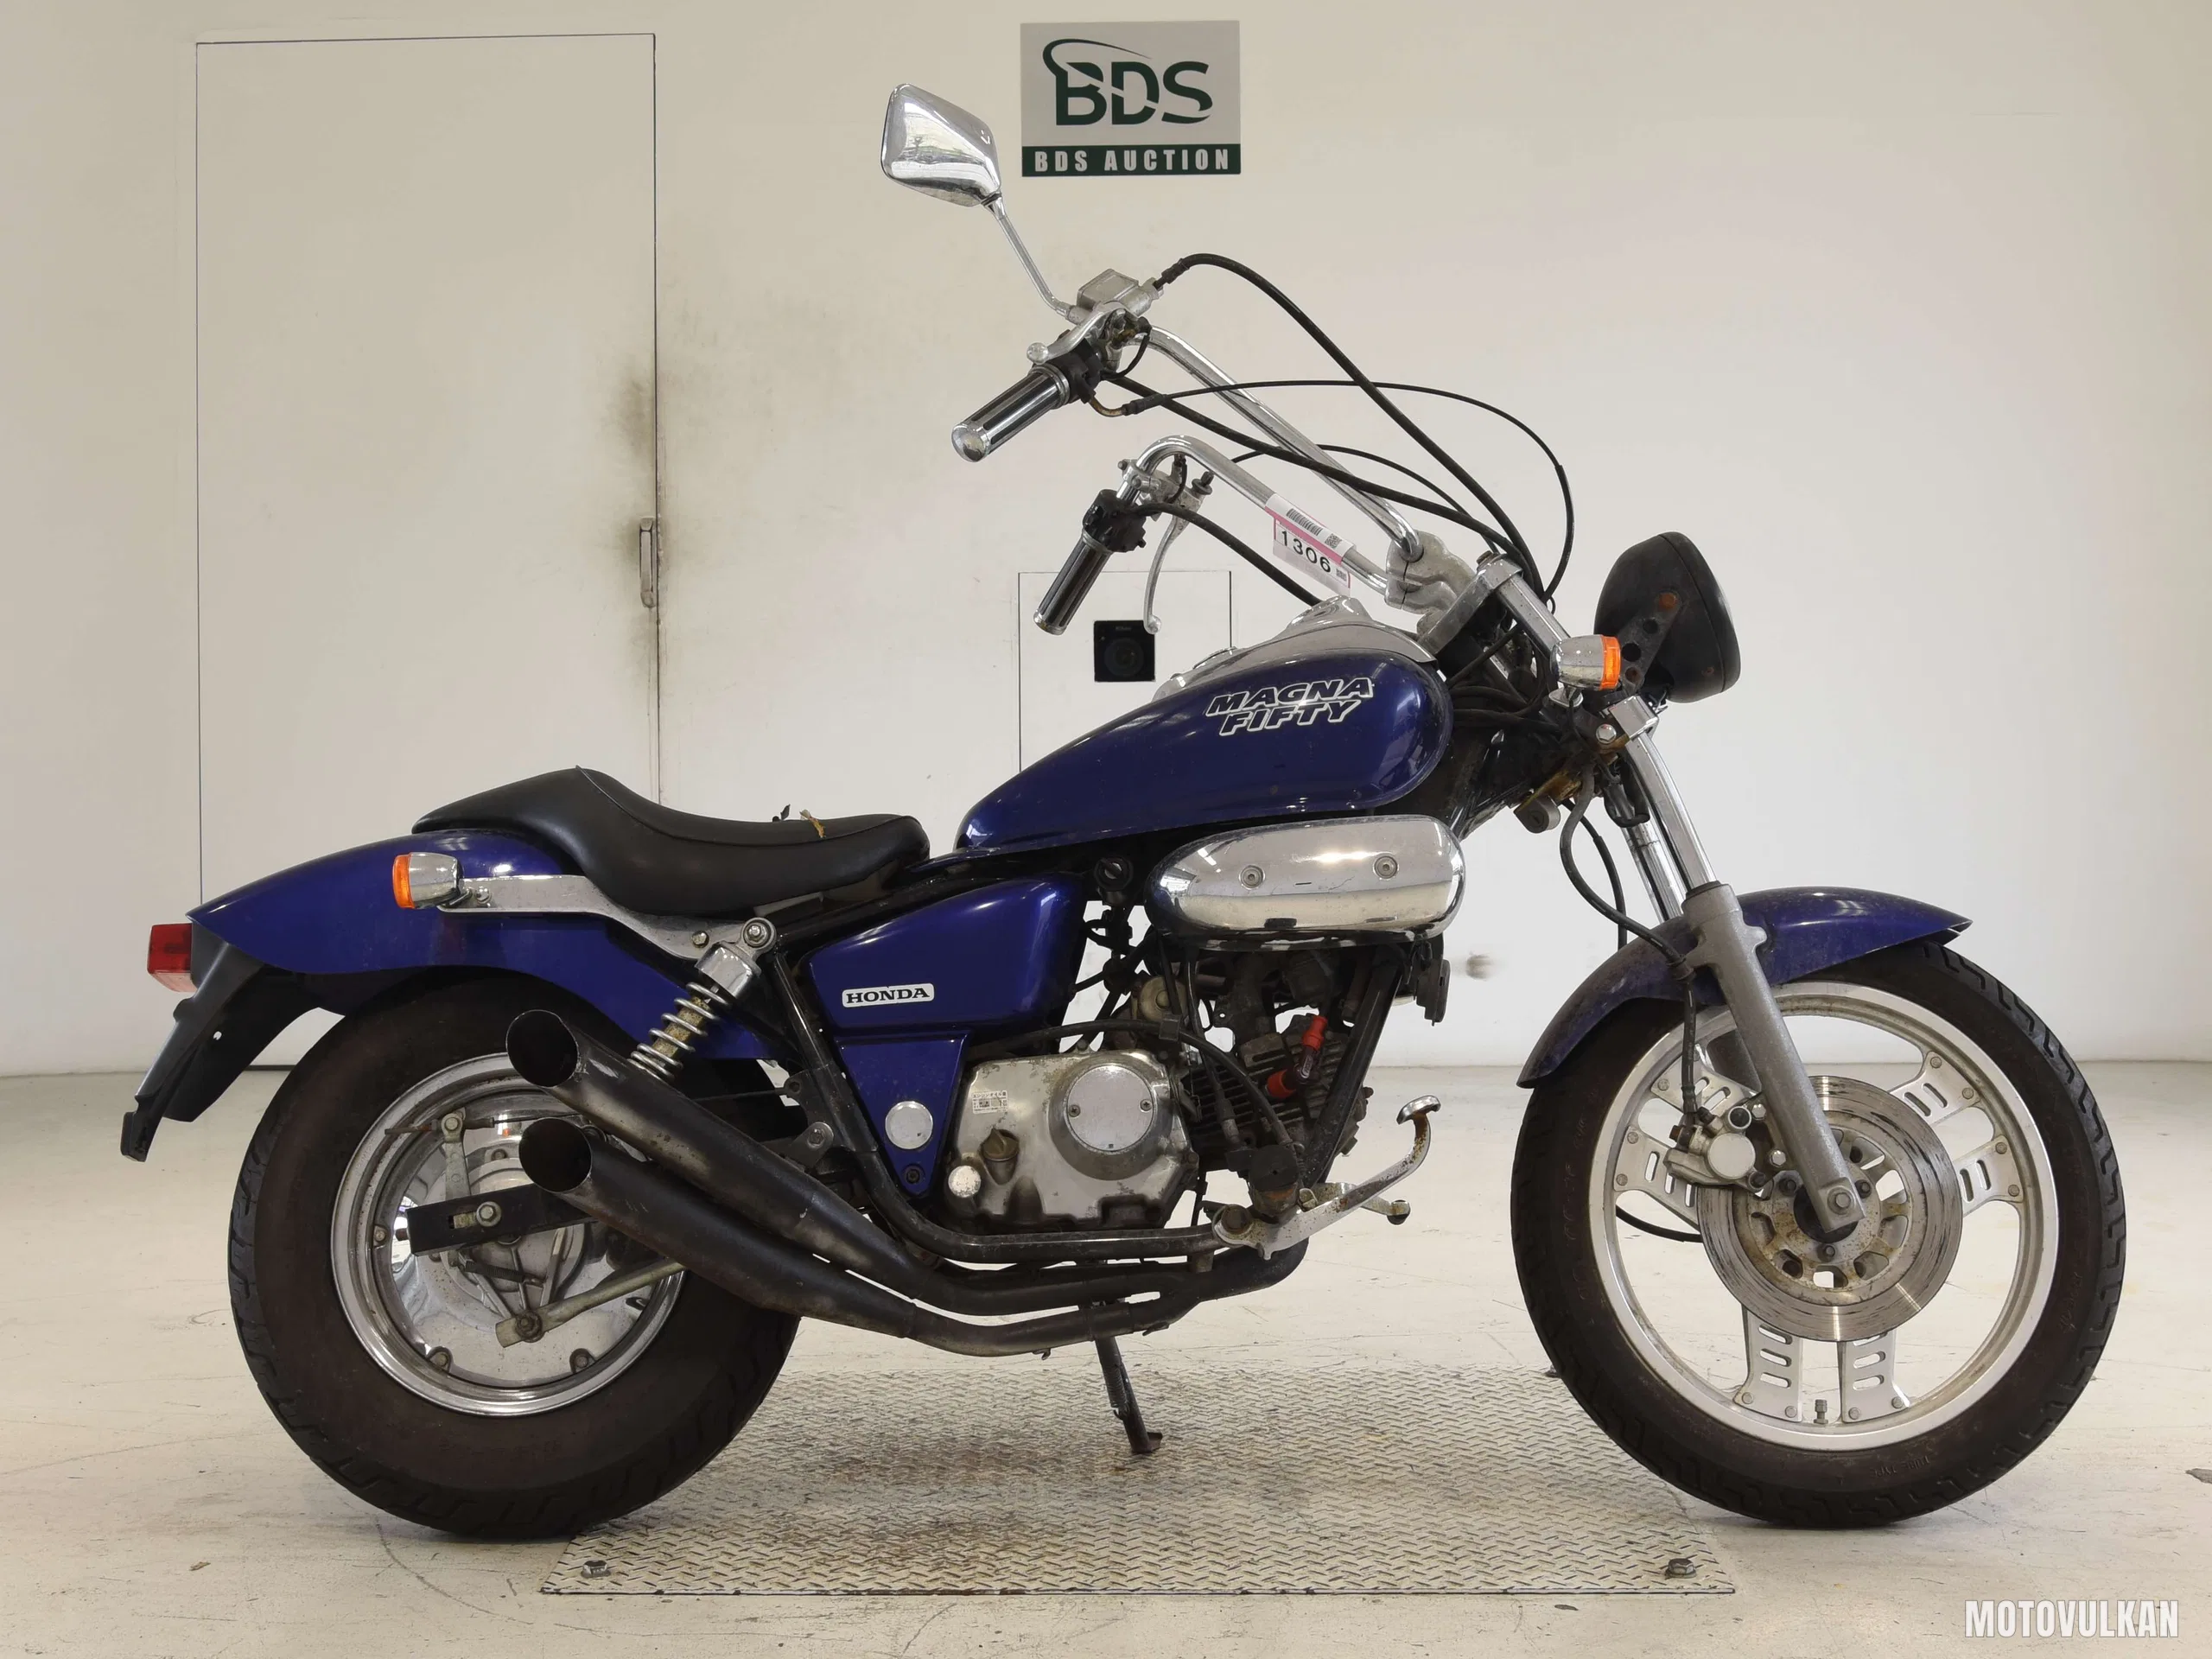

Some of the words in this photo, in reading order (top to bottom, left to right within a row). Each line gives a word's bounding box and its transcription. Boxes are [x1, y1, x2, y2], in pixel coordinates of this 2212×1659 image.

[1043, 39, 1213, 125] BDS
[1034, 149, 1088, 172] BDS
[1103, 149, 1230, 171] AUCTION
[1281, 531, 1332, 573] 1306
[1205, 677, 1374, 717] MAGNA
[1219, 700, 1362, 736] FIFTY
[846, 988, 930, 1003] HONDA
